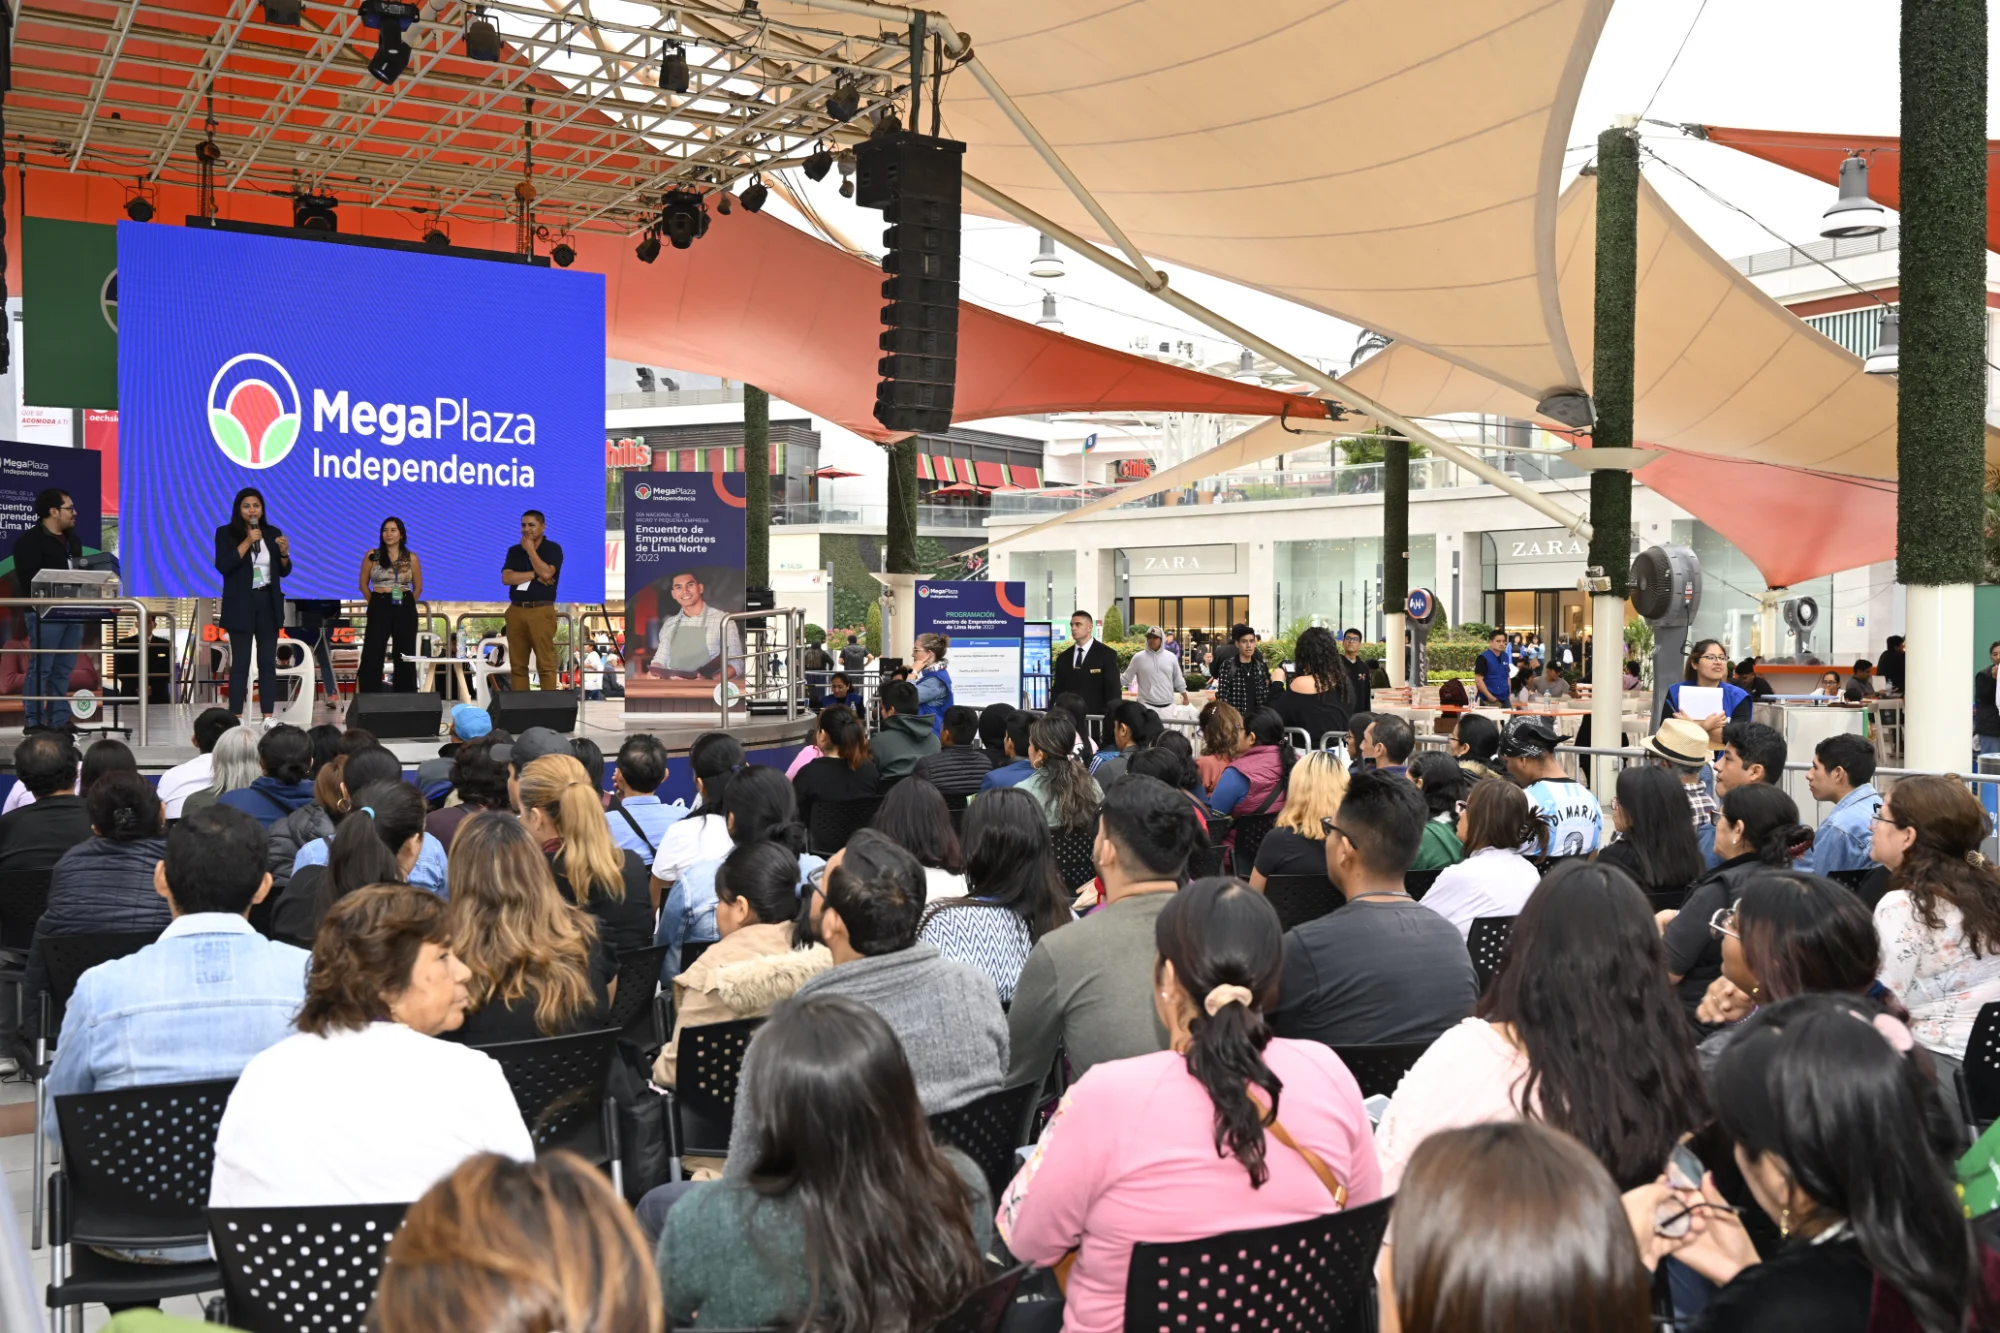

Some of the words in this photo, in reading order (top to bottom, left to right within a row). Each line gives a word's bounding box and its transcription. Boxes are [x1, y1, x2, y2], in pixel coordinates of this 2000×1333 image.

[21, 417, 56, 425] ACOMODA
[313, 388, 536, 446] MegaPlaza
[606, 436, 651, 468] hili's
[3, 458, 49, 470] MegaPlaza
[313, 447, 535, 488] Independencia
[3, 468, 49, 477] Independencia
[653, 487, 696, 496] MegaPlaza
[635, 525, 688, 534] Encuentro
[691, 525, 704, 534] de
[635, 534, 716, 544] Emprendedores
[635, 543, 648, 553] de
[651, 543, 676, 553] Lima
[679, 544, 708, 553] Norte
[1511, 540, 1585, 557] ZARA
[635, 553, 660, 562] 2023
[1145, 556, 1200, 570] ZARA
[945, 610, 995, 618] PROGRAMACIÓN
[1552, 809, 1564, 827] DI
[1566, 804, 1598, 826] MARIA
